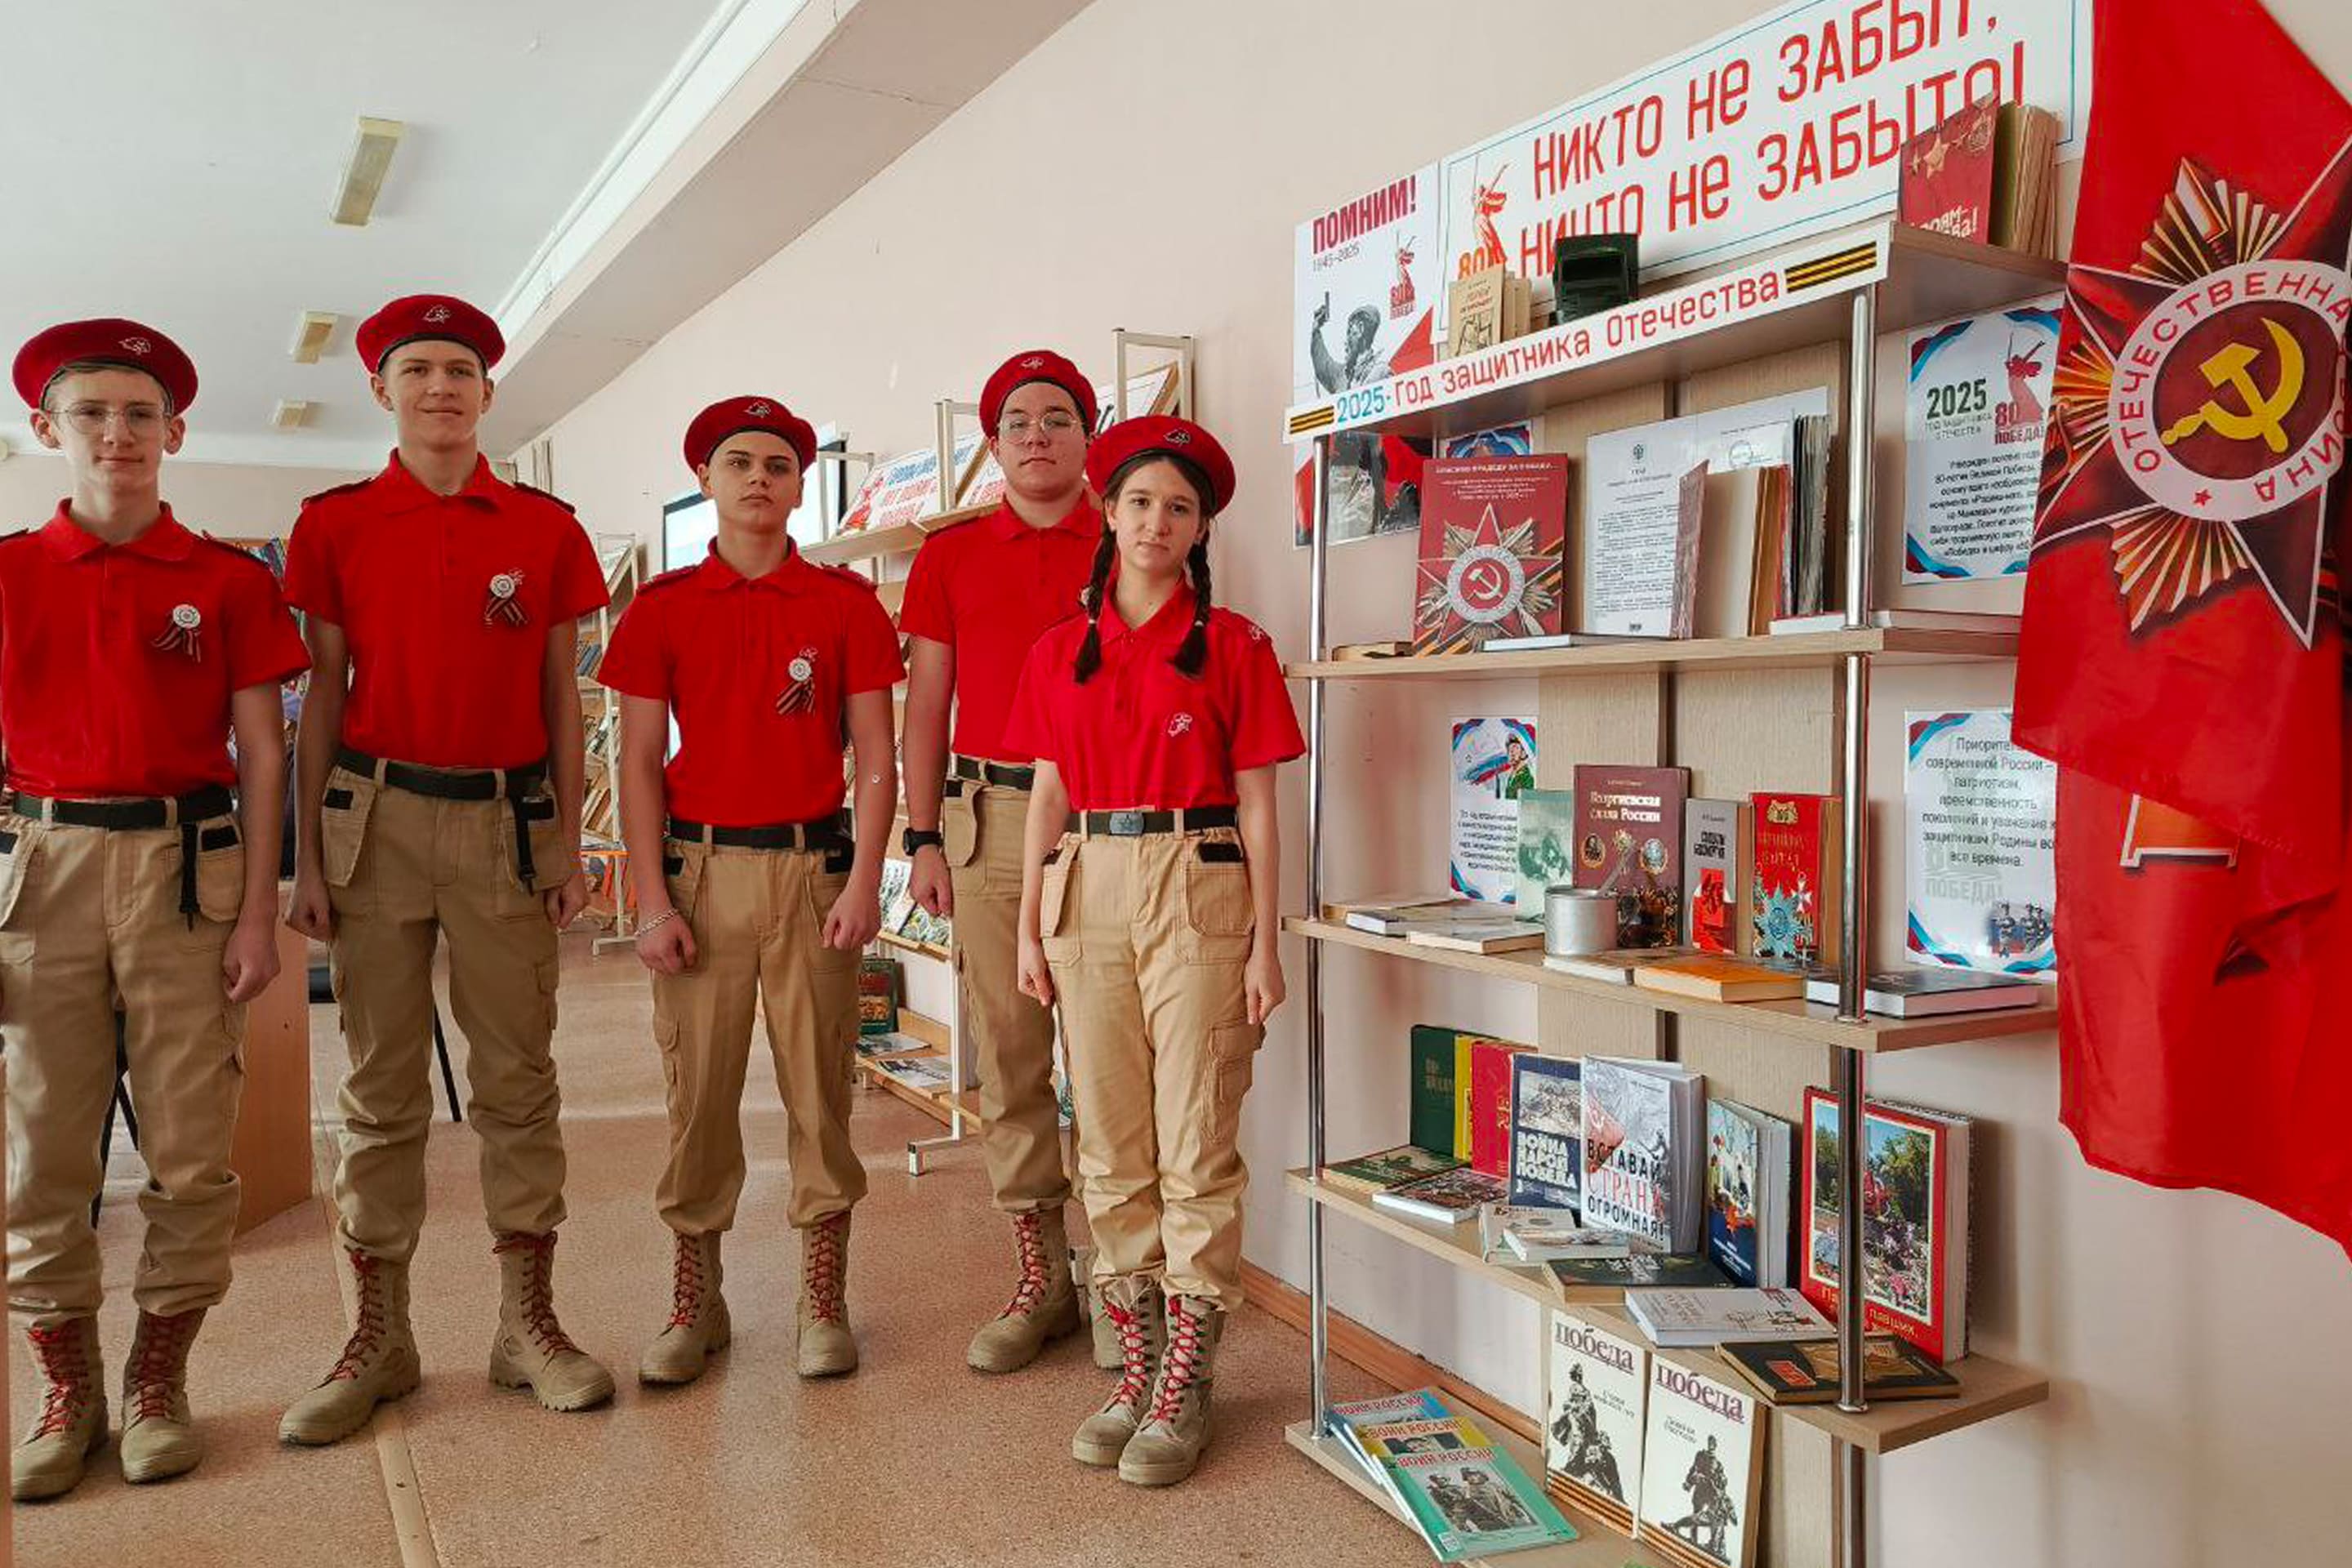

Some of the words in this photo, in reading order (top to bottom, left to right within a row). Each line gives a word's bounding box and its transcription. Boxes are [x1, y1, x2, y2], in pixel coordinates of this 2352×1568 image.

[1534, 95, 1664, 200] НИКТО
[1312, 174, 1416, 255] ПОМНИМ!
[1443, 328, 1591, 394] защитника
[1606, 270, 1780, 347] Отечества
[2118, 271, 2352, 472] ОТЕЧЕСТВЕННА
[1927, 378, 1987, 421] 2025
[1956, 737, 2015, 753] Приорите
[2001, 756, 2043, 771] России
[1588, 1195, 1664, 1241] ОГРОМНАЯ!
[1554, 1322, 1634, 1372] победа
[1374, 1395, 1425, 1410] РОССИИ
[1656, 1363, 1744, 1421] победа
[1408, 1419, 1464, 1434] РОССИИ
[1439, 1447, 1498, 1463] РОССИИ
